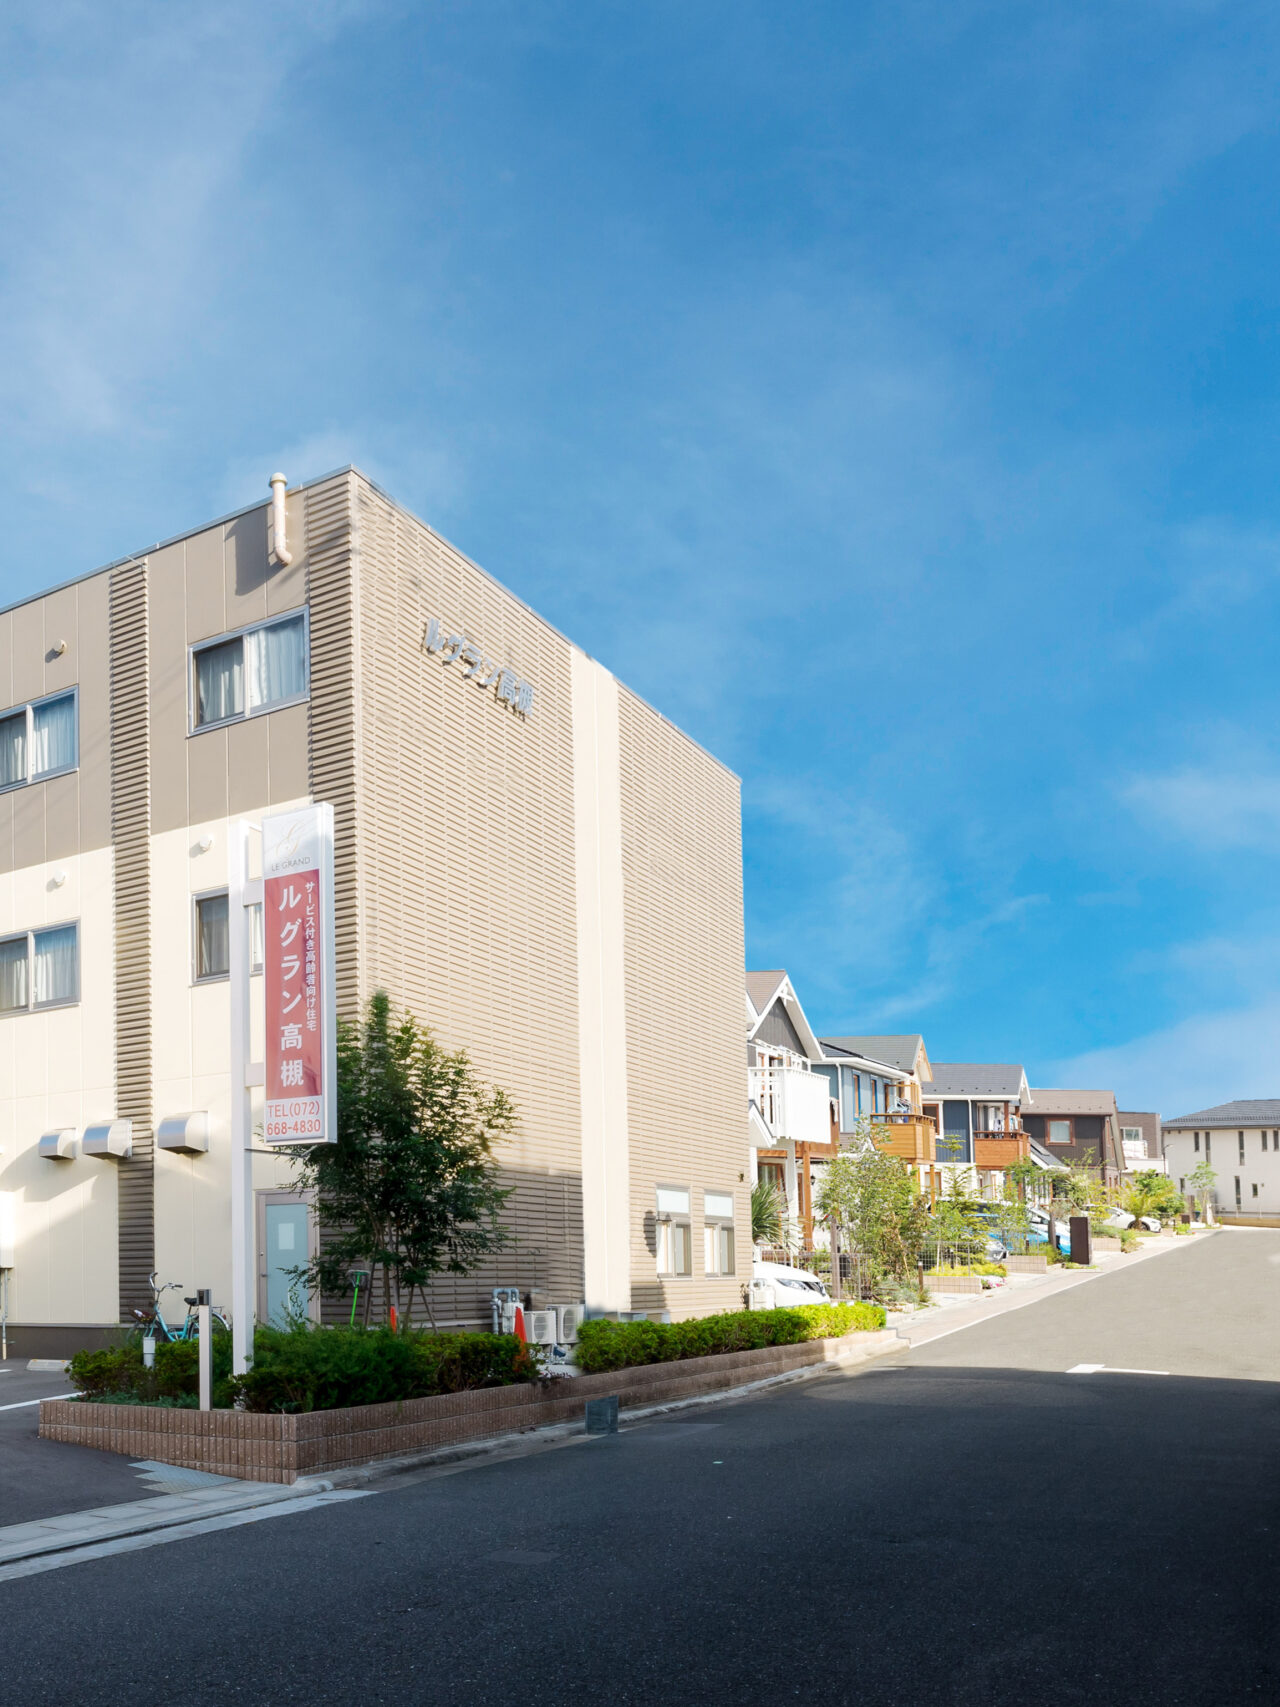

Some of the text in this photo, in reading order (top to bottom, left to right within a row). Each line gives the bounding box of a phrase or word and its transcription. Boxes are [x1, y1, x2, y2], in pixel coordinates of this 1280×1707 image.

[281, 857, 311, 869] GRAND
[305, 881, 317, 1032] サービス付き高齢者向け住宅
[279, 885, 304, 1088] ルグラン高槻
[267, 1100, 320, 1118] TEL(072)
[267, 1119, 321, 1135] 668-4830
